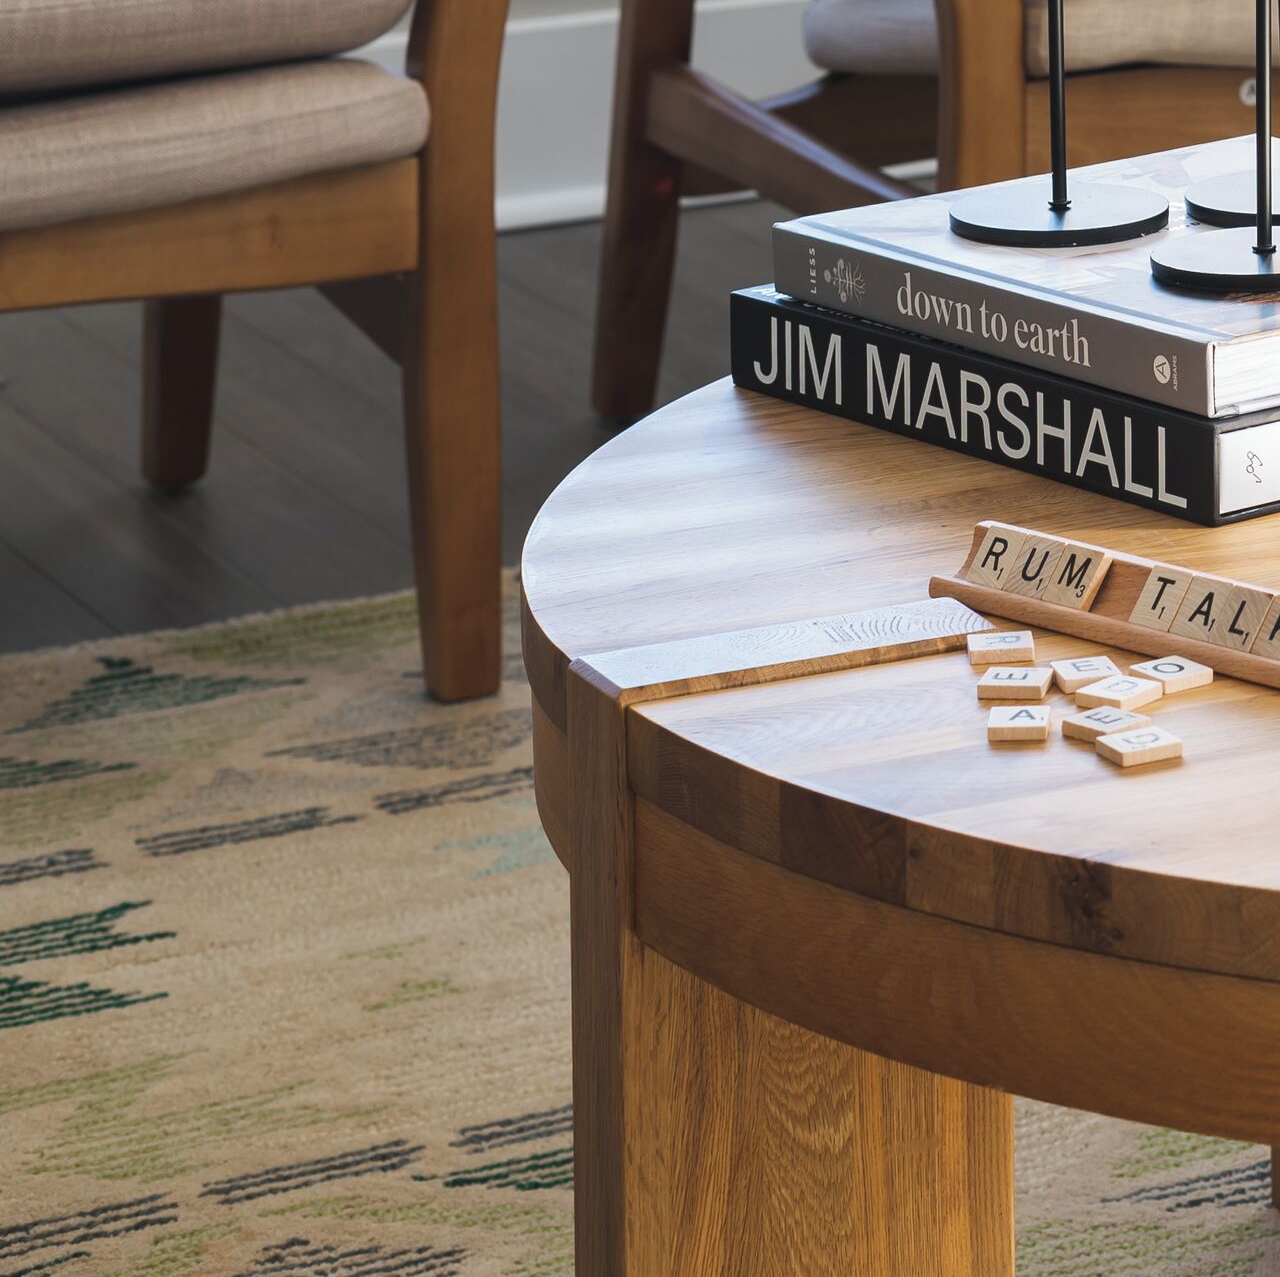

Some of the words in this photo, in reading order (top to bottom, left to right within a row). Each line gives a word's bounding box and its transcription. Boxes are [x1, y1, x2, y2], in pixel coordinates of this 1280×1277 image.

[808, 246, 818, 295] LIESS
[896, 271, 974, 333] down
[980, 298, 1009, 343] to
[1013, 318, 1092, 369] earth
[1171, 354, 1179, 392] ABRAMS
[753, 316, 842, 406] JIM
[866, 343, 1188, 510] MARSHALL
